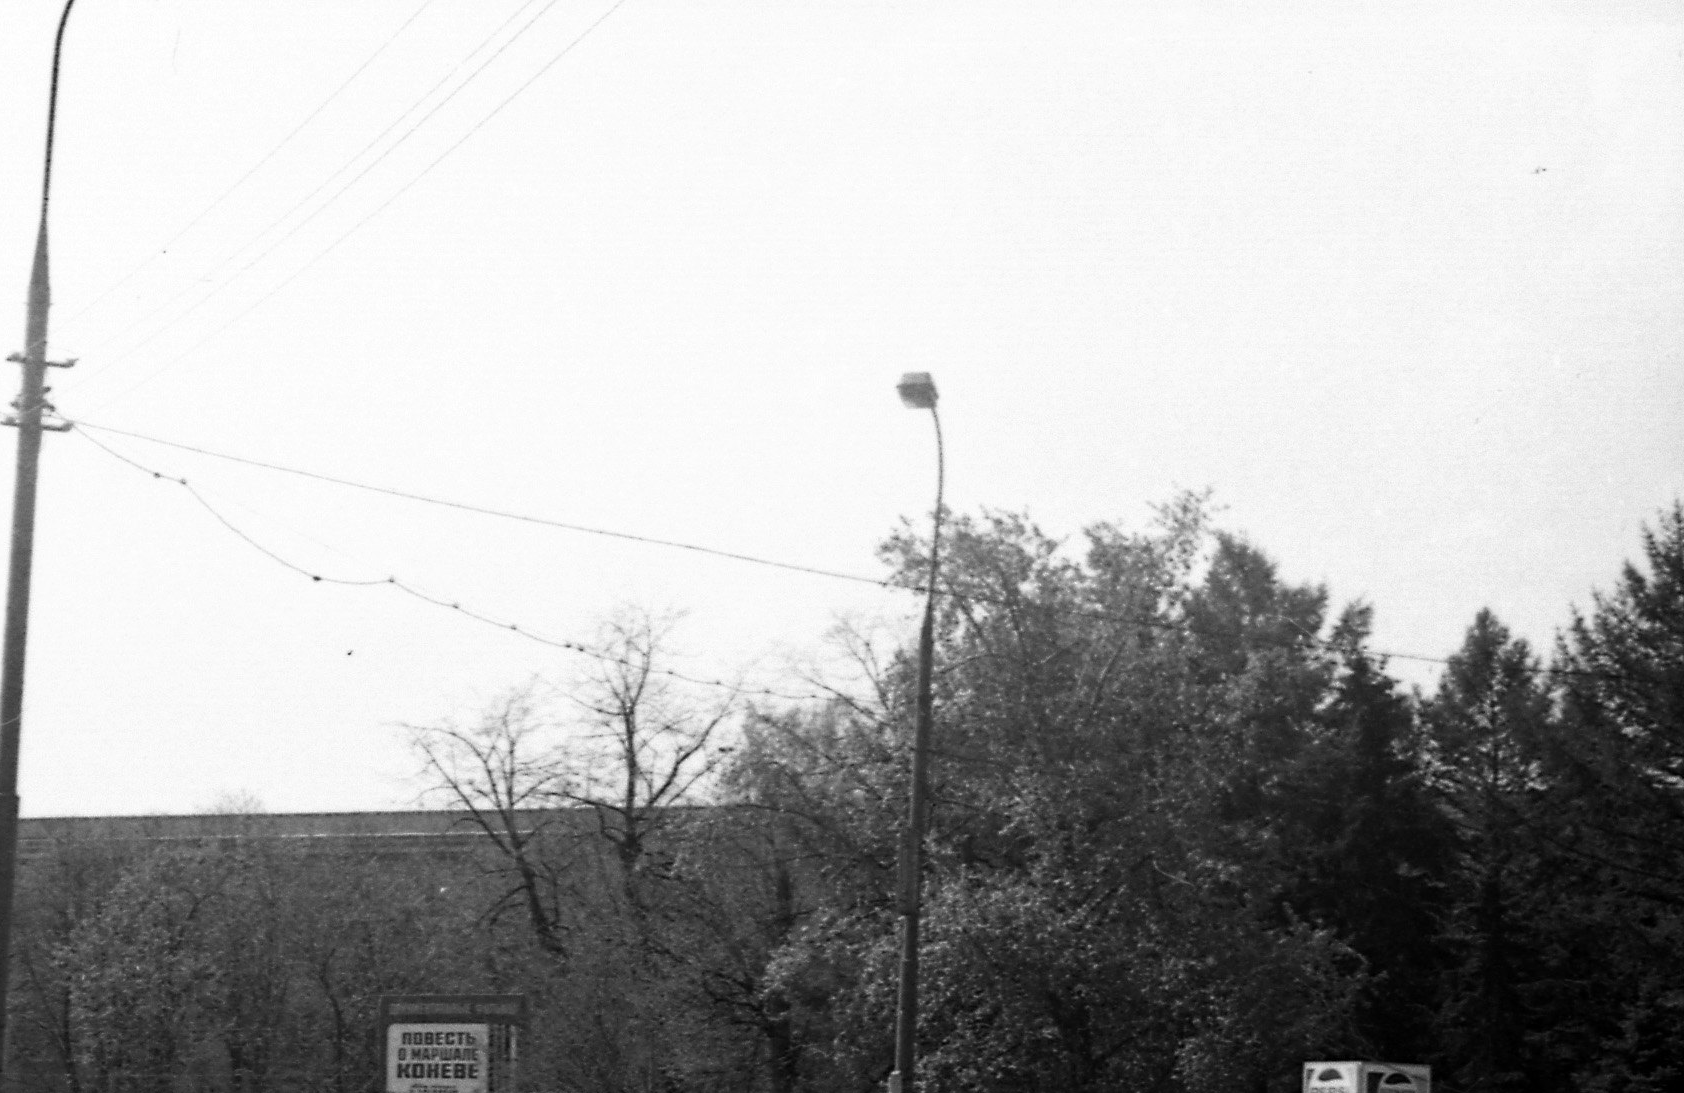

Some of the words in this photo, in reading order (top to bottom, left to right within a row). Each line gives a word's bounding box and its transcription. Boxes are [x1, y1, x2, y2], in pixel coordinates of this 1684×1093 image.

[402, 1031, 477, 1046] ПОВЕСТЬ
[398, 1048, 407, 1061] О
[411, 1048, 479, 1061] МАРШАЛЕ
[397, 1063, 479, 1079] КОНЕВЕ
